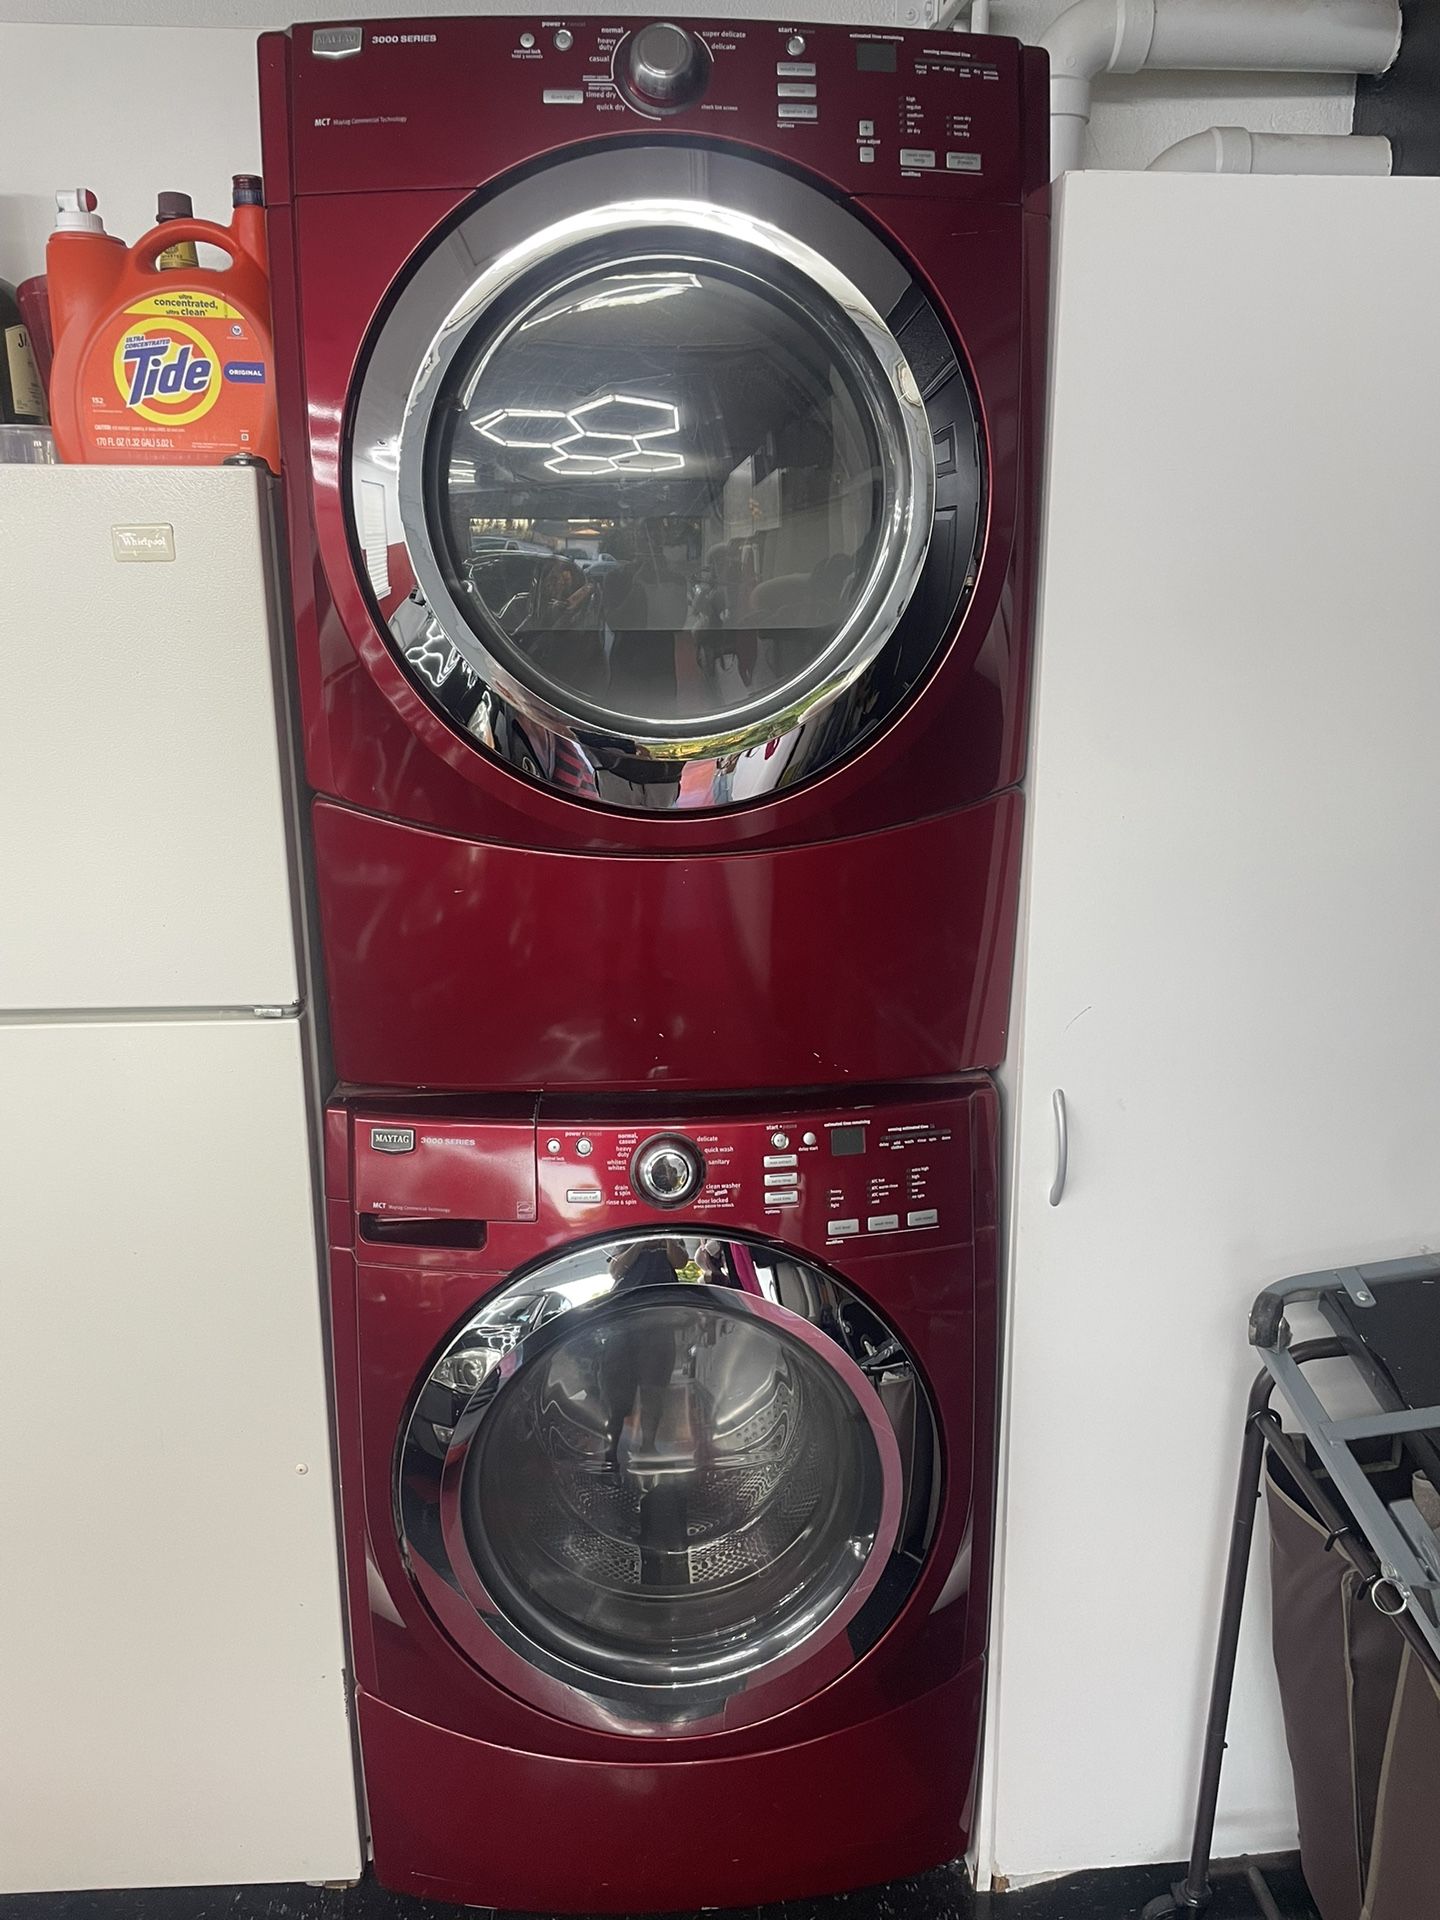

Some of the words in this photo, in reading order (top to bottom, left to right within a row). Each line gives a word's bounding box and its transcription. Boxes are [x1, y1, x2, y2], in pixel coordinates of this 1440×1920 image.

[372, 35, 399, 44] 3000
[400, 34, 437, 43] SERIES
[721, 31, 746, 39] delicate
[599, 44, 614, 52] duty
[596, 104, 613, 112] quick
[314, 118, 331, 127] MCT
[153, 298, 219, 310] concentrated,
[124, 339, 171, 349] CONCENTRATED
[125, 335, 145, 343] ULTRA
[123, 345, 212, 406] Tide
[228, 369, 263, 377] ORIGINAL
[95, 437, 107, 446] 170
[108, 438, 115, 446] FL
[115, 438, 125, 446] OZ
[125, 438, 141, 448] (1.32
[141, 439, 156, 448] GAL)
[156, 438, 170, 447] 5.02
[170, 439, 175, 447] L
[118, 532, 166, 548] Whirlpool
[375, 1134, 410, 1144] MAYTAG
[420, 1136, 443, 1146] 3000
[444, 1138, 476, 1146] SERIES
[373, 1201, 387, 1209] MCT
